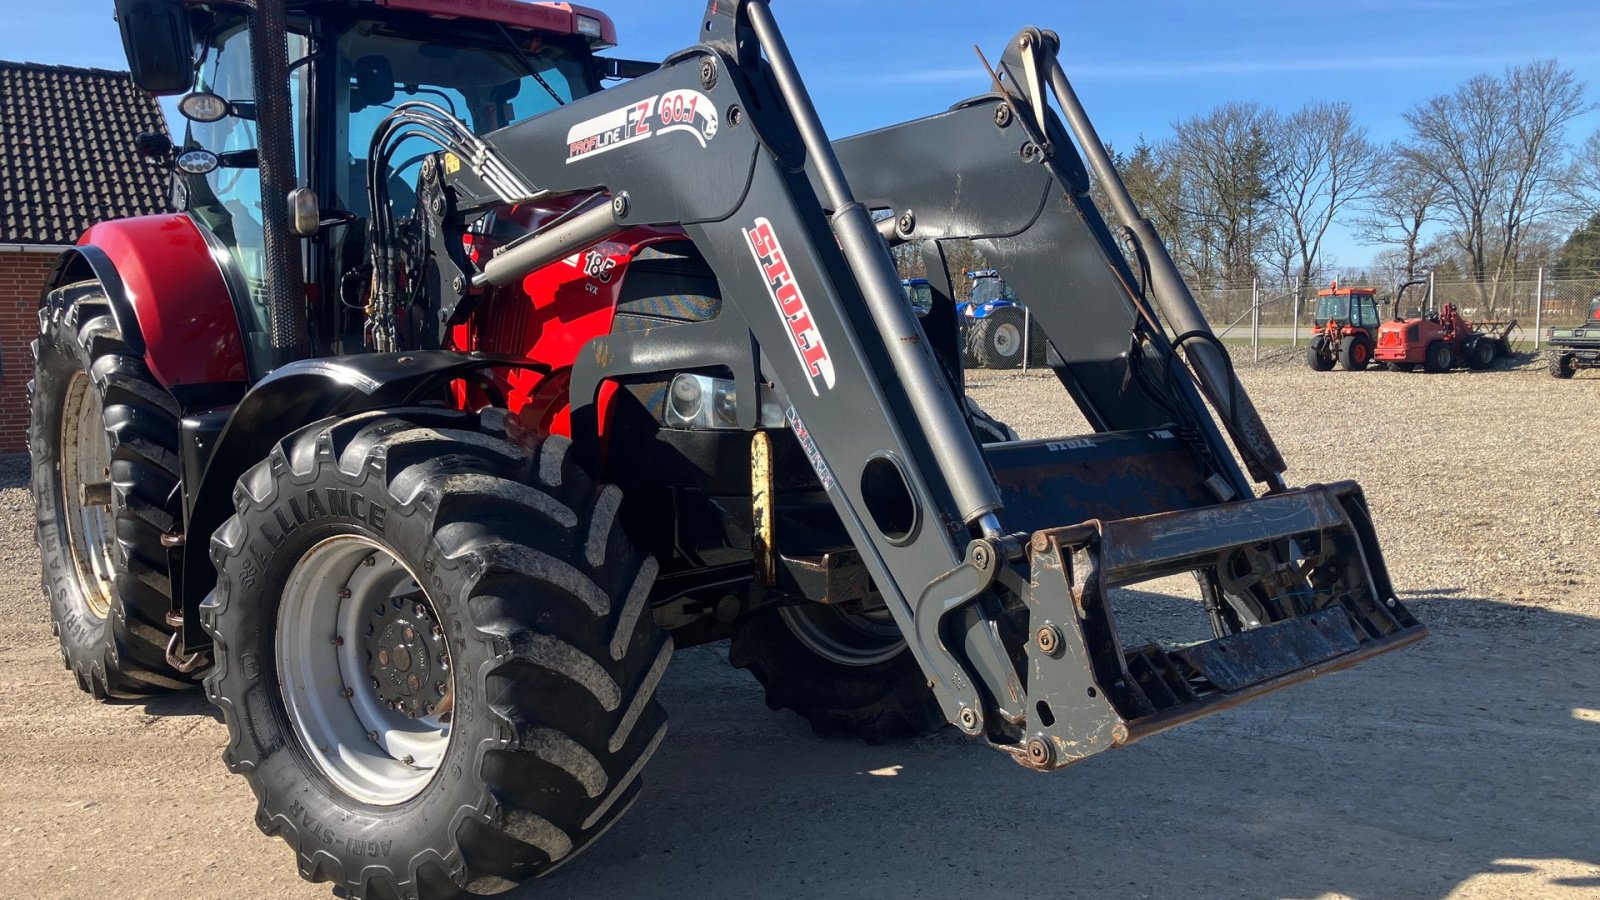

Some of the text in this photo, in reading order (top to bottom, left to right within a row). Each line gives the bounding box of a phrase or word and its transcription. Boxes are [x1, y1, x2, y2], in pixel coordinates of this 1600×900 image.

[625, 101, 650, 138] FZ
[661, 94, 698, 125] 60.1
[584, 251, 616, 283] 185
[585, 283, 598, 295] CVX
[748, 223, 829, 377] STOLL
[249, 487, 387, 575] ALLIANCE
[290, 799, 393, 858] AGRI-STAR
